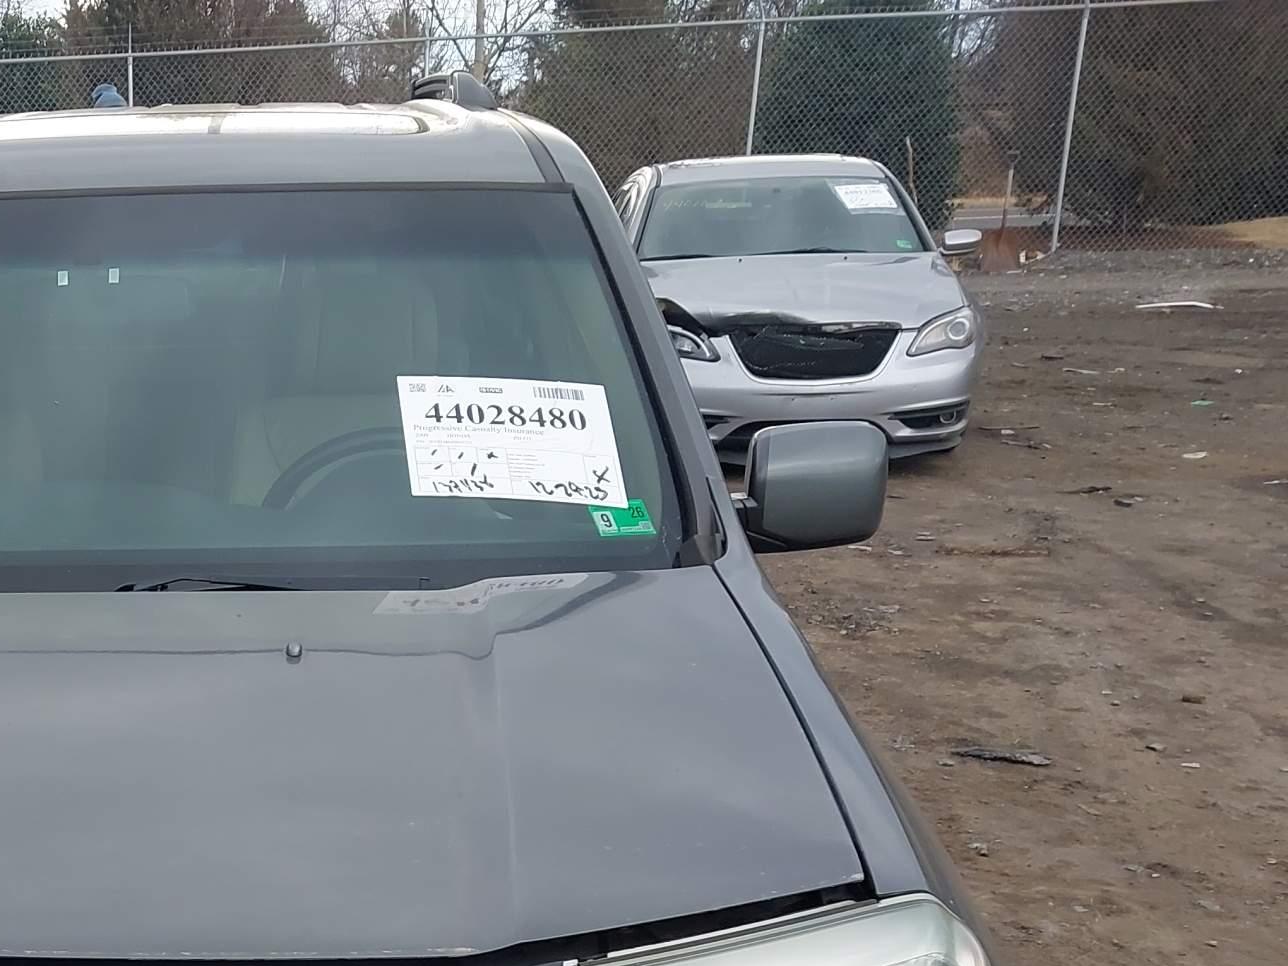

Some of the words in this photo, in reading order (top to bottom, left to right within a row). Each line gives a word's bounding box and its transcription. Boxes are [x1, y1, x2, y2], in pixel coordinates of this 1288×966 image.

[424, 402, 587, 430] 44028480
[504, 427, 545, 436] Insurance
[600, 513, 613, 528] 9
[629, 506, 645, 518] 26
